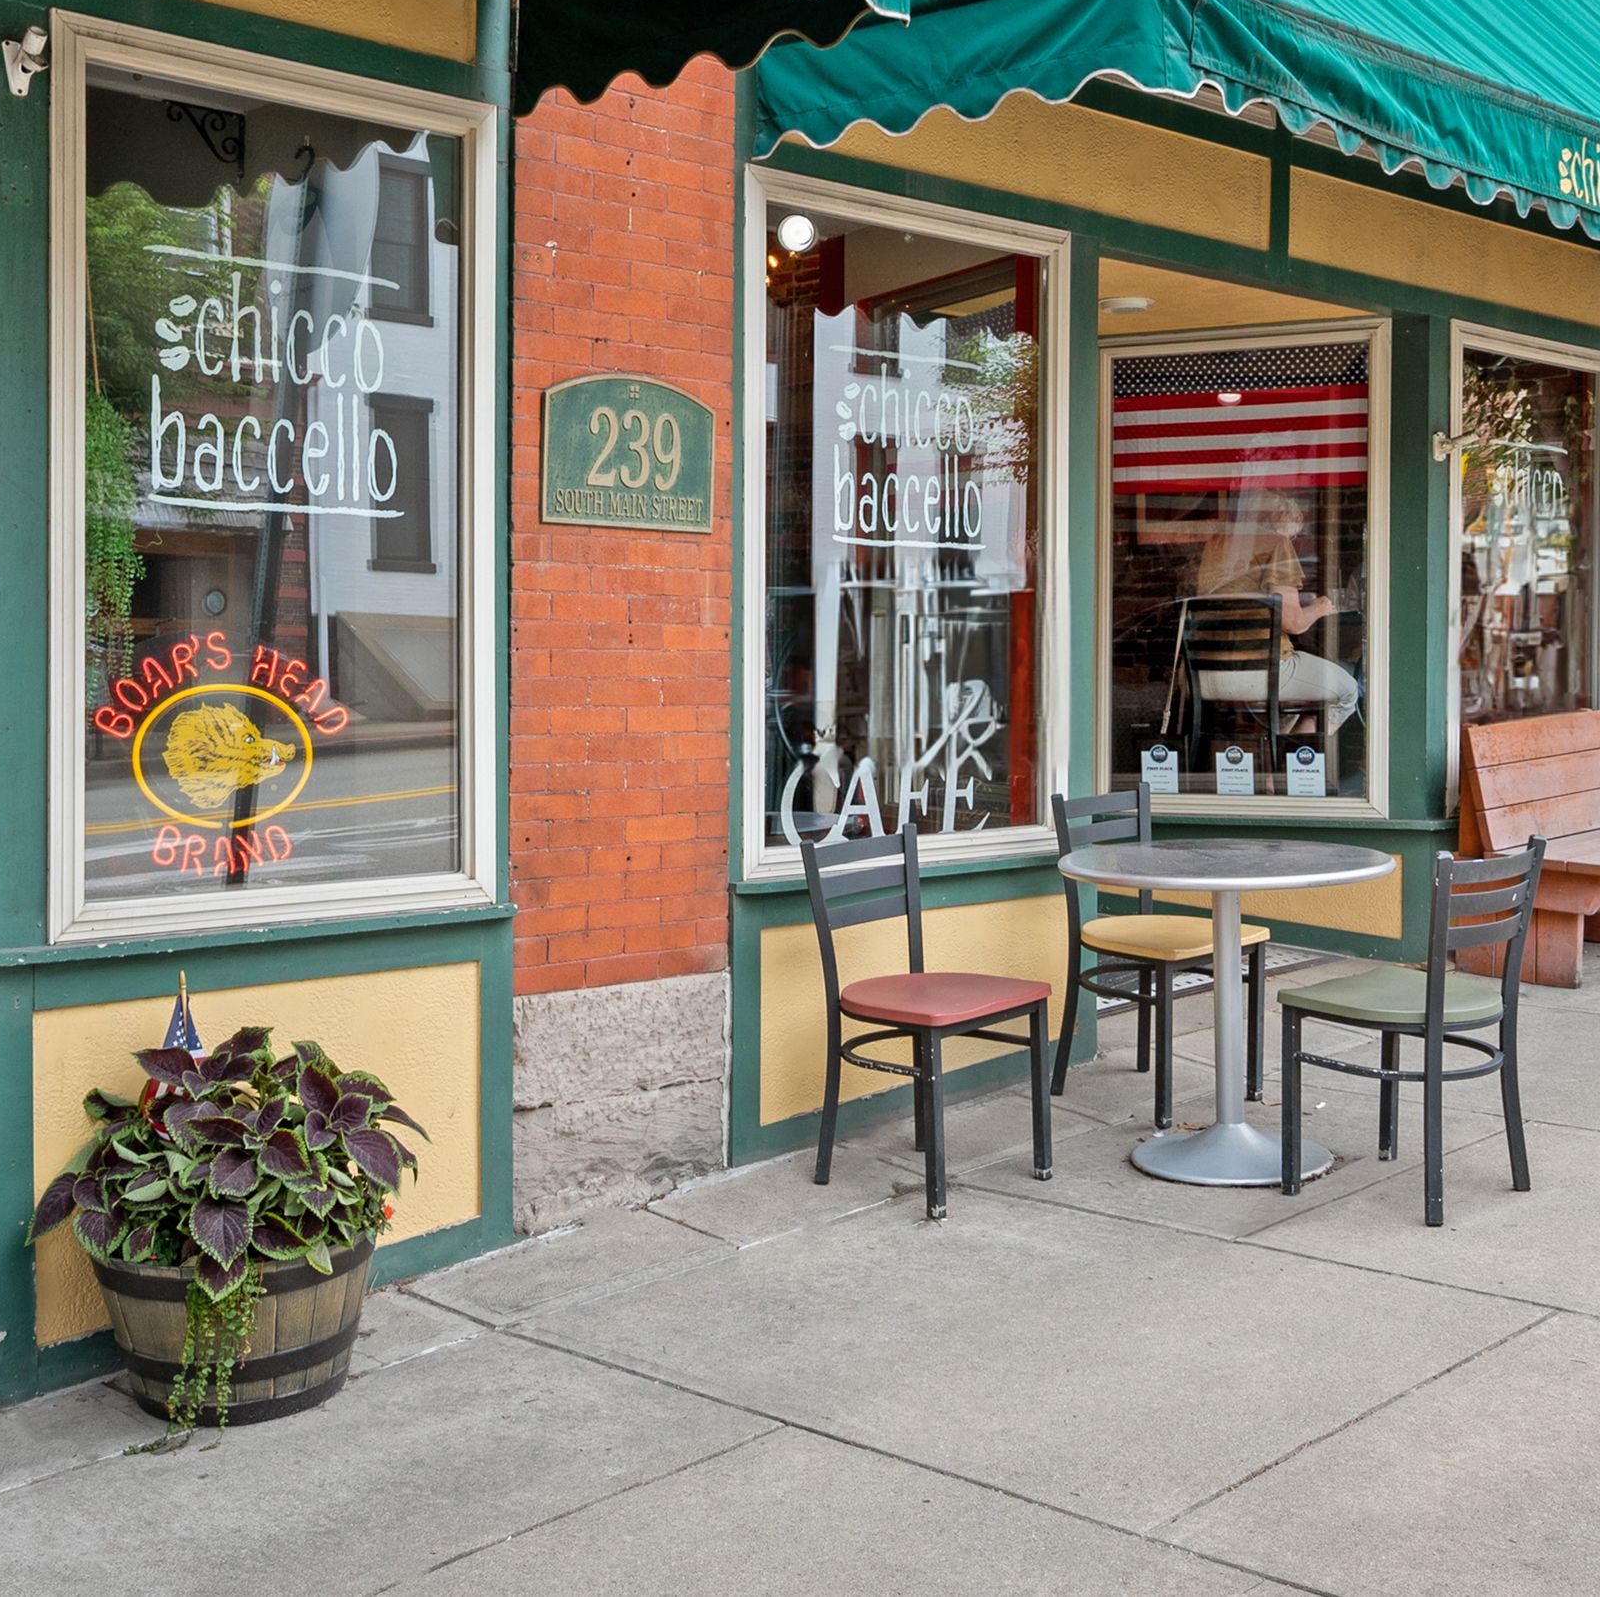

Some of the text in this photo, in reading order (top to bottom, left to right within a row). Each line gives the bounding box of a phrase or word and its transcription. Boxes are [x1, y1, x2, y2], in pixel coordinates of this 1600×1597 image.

[195, 271, 385, 394] chicco
[151, 374, 398, 502] baccello
[587, 406, 682, 492] 239
[859, 362, 975, 454] chicco
[555, 488, 704, 523] SOUTH MAIN STREET
[833, 444, 983, 539] baccello
[94, 631, 349, 739] BOAR'S HEAD
[152, 824, 293, 878] BRAND
